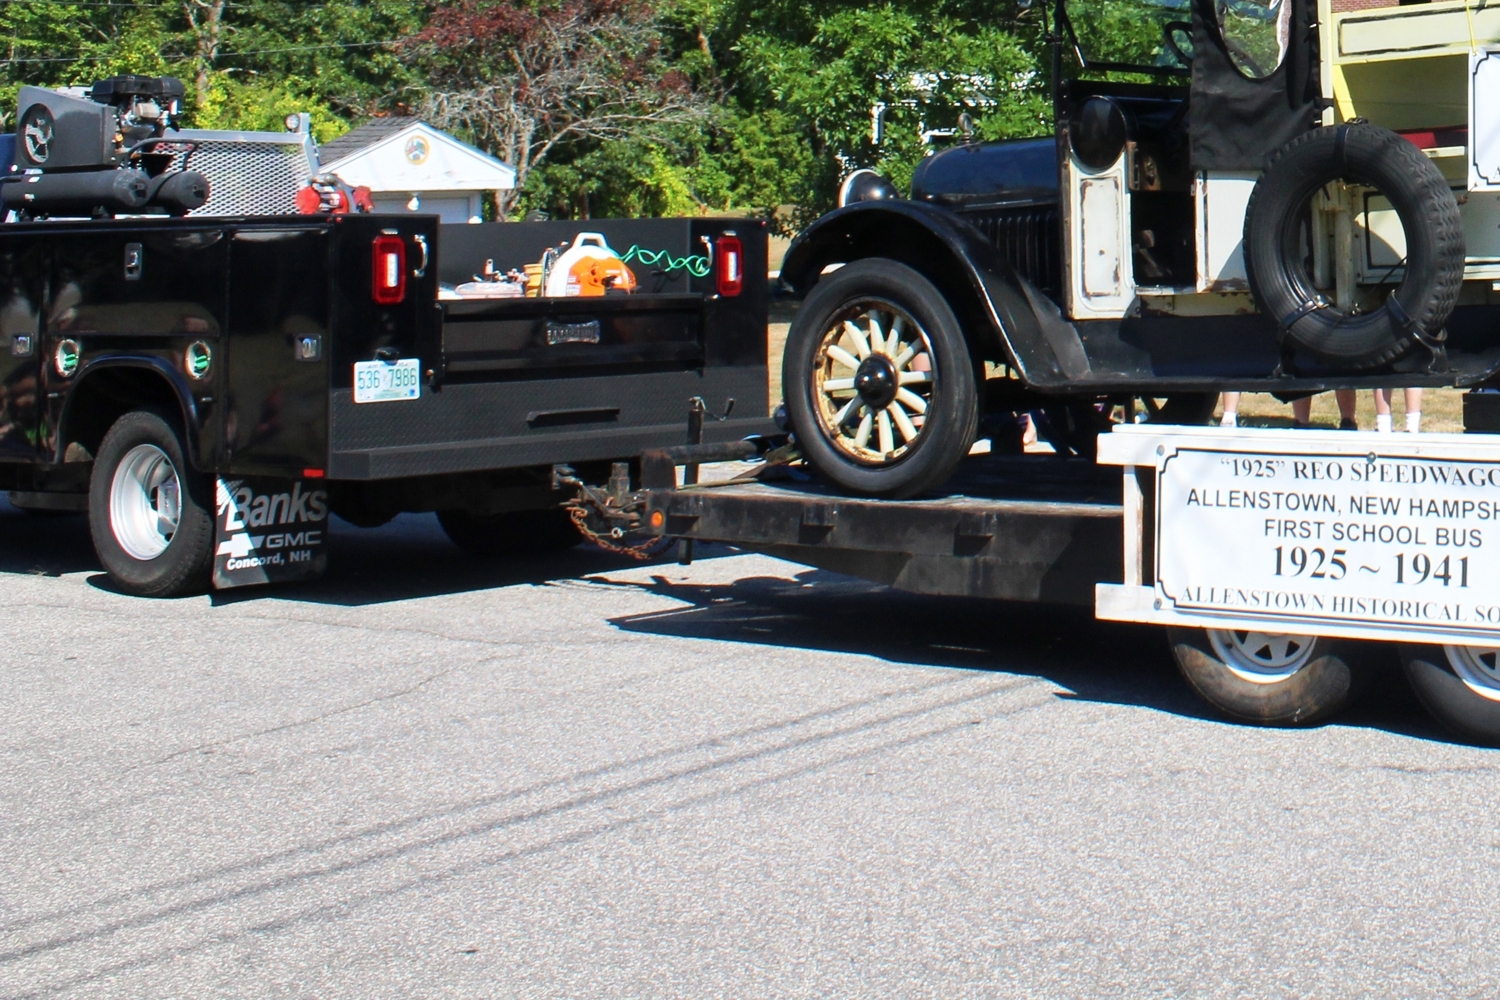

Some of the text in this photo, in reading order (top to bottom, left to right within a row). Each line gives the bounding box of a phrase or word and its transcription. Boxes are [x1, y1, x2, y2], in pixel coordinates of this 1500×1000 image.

[358, 367, 417, 390] 536 7986
[1220, 457, 1285, 478] “1925”
[1293, 460, 1343, 480] REO
[225, 481, 328, 531] Banks
[1186, 488, 1342, 516] ALLENSTOWN,
[1349, 496, 1401, 516] NEW
[266, 530, 322, 549] GMC
[1264, 518, 1483, 548] FIRST SCHOOL BUS
[226, 549, 311, 571] Concord, NH
[1273, 545, 1348, 580] 1925
[1394, 552, 1470, 588] 1941
[1181, 586, 1326, 611] ALLENSTOWN
[1332, 595, 1469, 623] HISTORICAL
